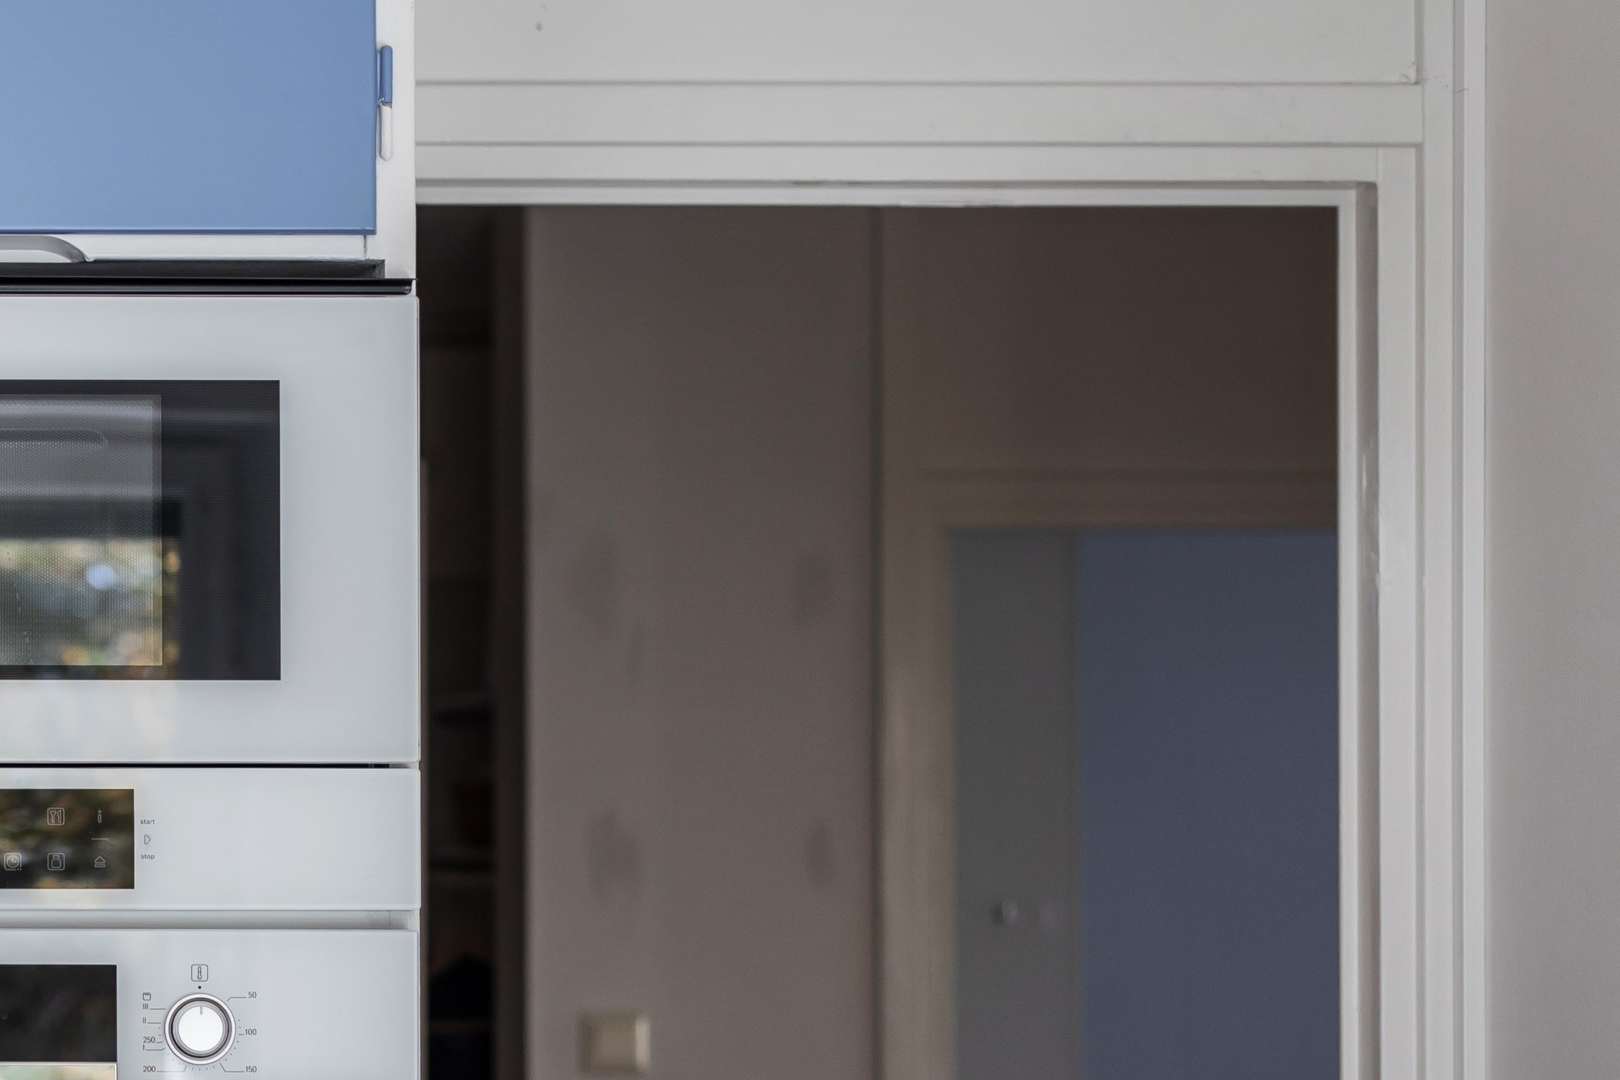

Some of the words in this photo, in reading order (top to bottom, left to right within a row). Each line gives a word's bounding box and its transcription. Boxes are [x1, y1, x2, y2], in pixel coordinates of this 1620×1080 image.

[248, 991, 257, 999] 50
[245, 1028, 257, 1036] 100
[142, 1036, 156, 1044] 250
[142, 1065, 156, 1073] 200
[245, 1065, 257, 1073] 150
